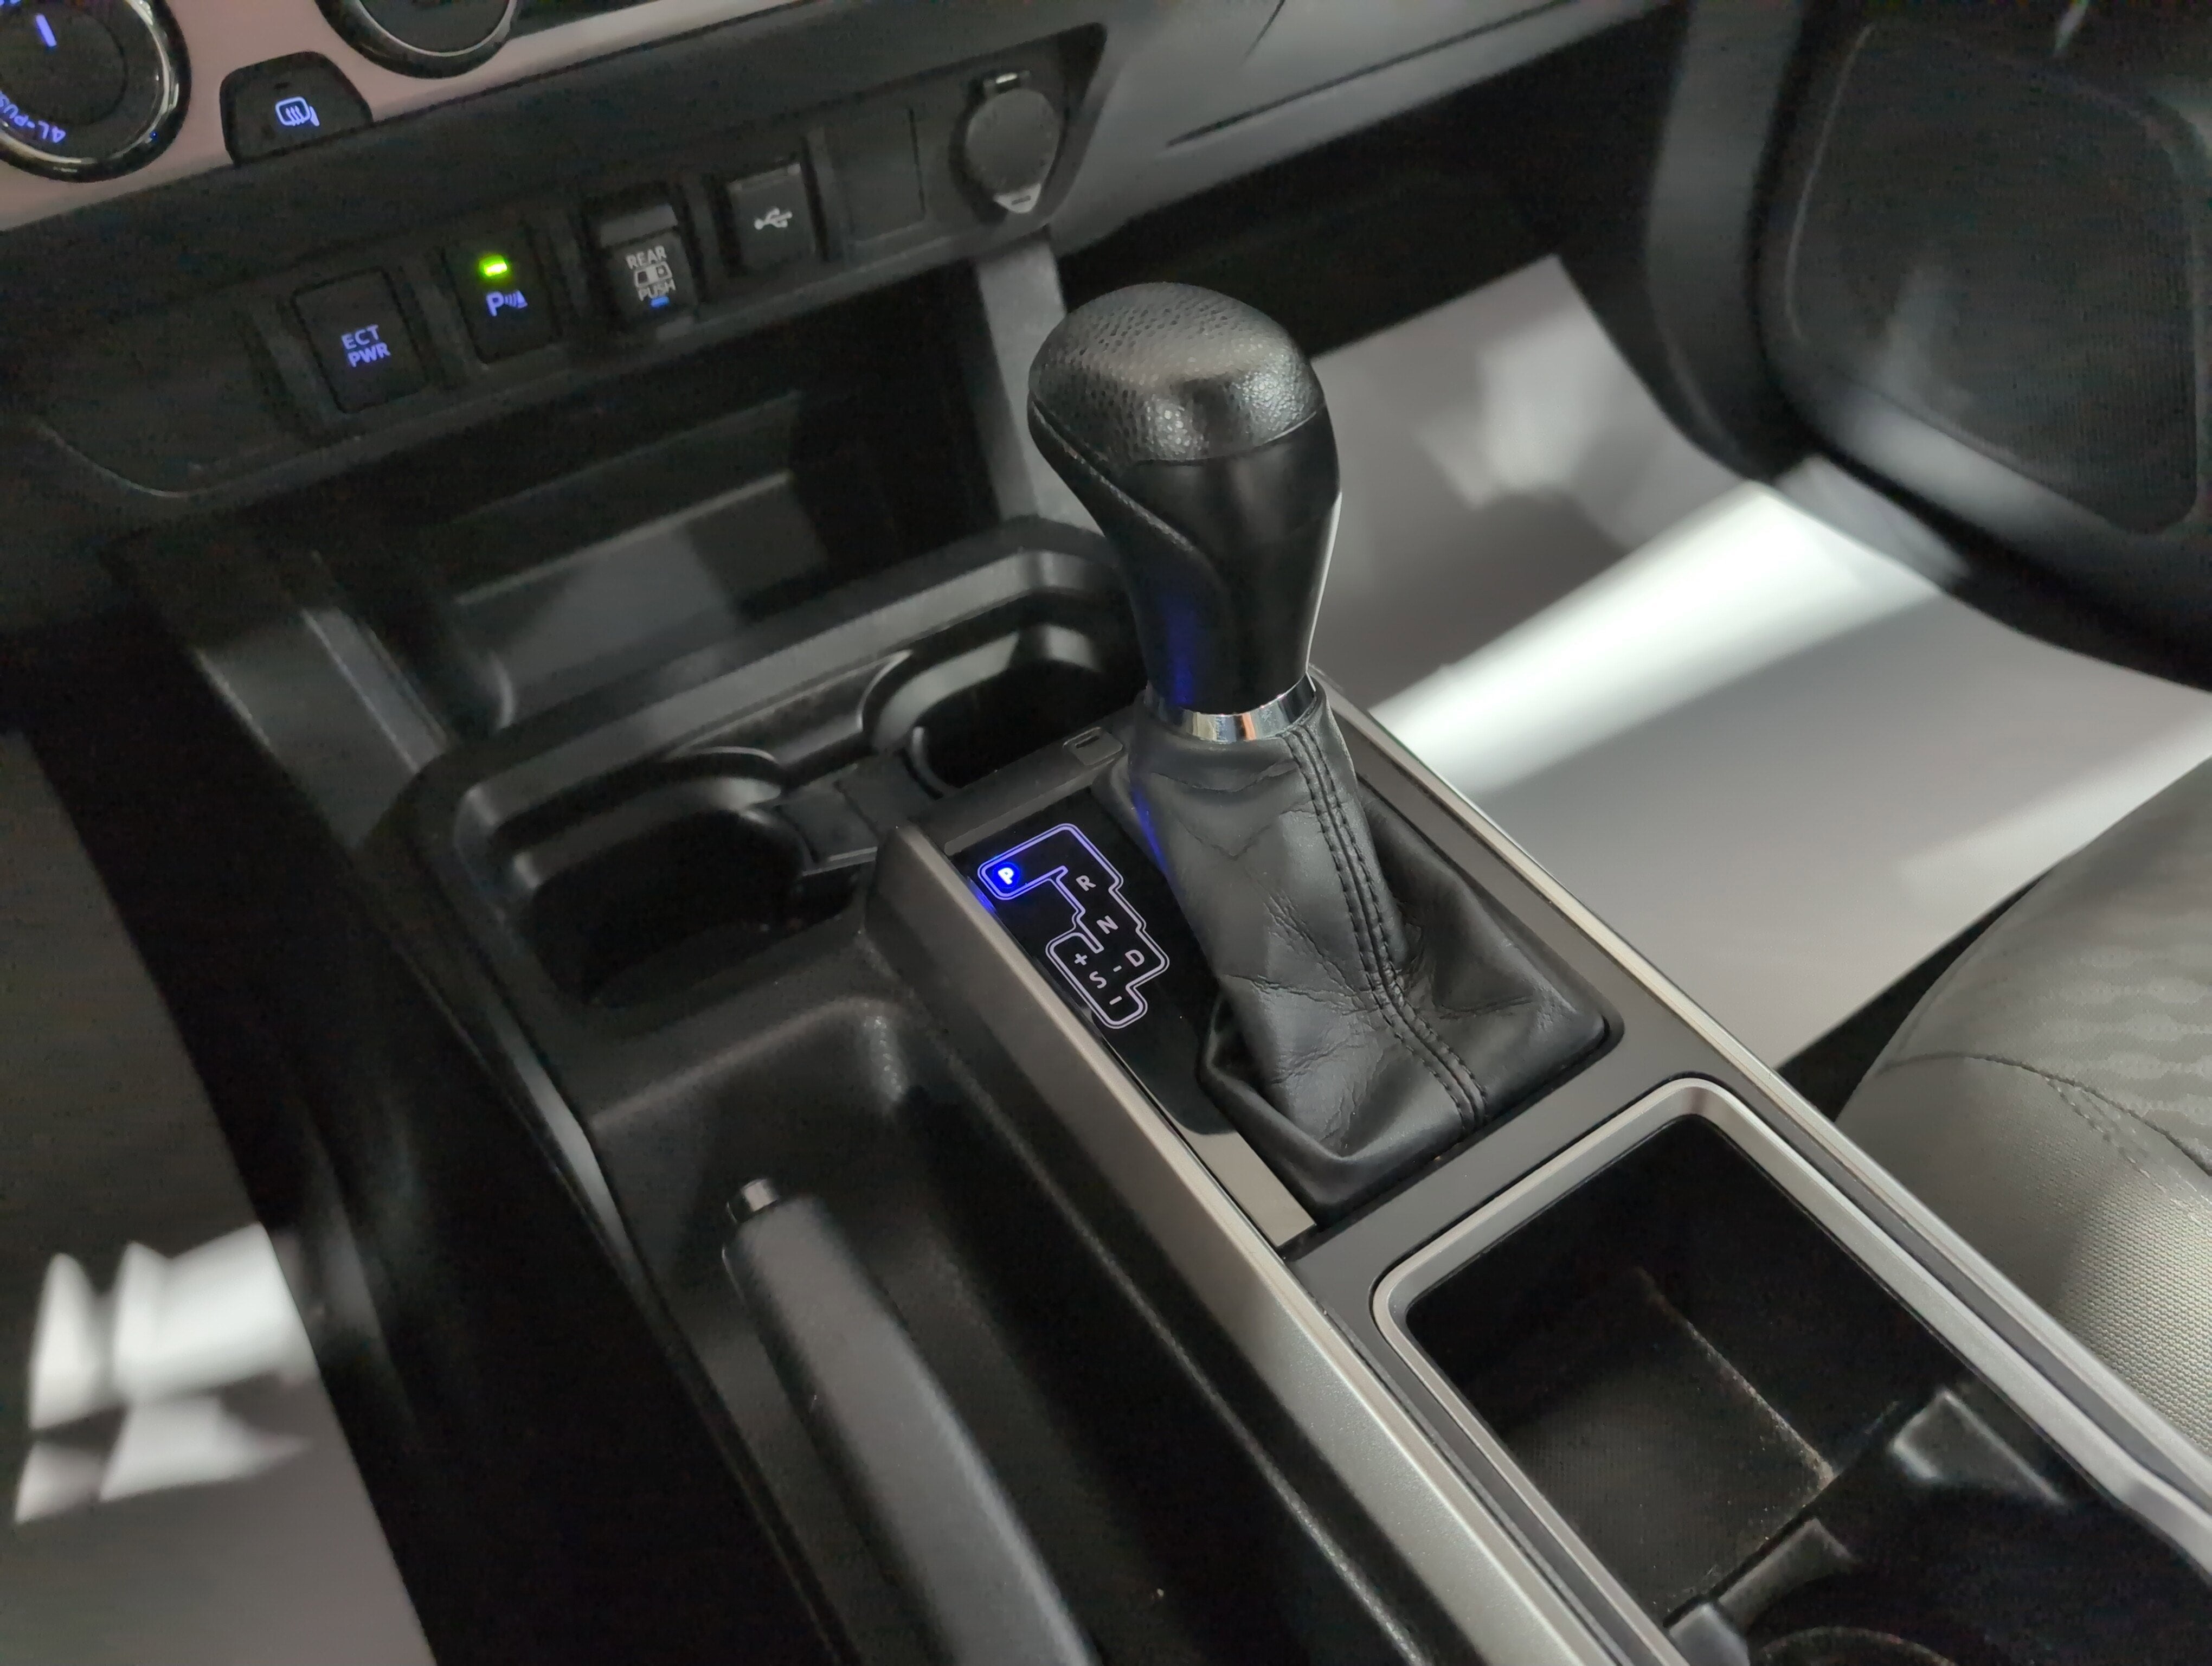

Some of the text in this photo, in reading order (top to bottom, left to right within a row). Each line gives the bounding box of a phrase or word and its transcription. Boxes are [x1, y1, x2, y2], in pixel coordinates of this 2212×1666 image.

[626, 245, 667, 270] REAR
[341, 324, 379, 350] ECT
[348, 342, 391, 368] PWR
[998, 868, 1014, 885] P
[1076, 875, 1096, 891] R
[1096, 915, 1118, 934] N
[1089, 971, 1107, 989] S
[1125, 950, 1144, 967] D
